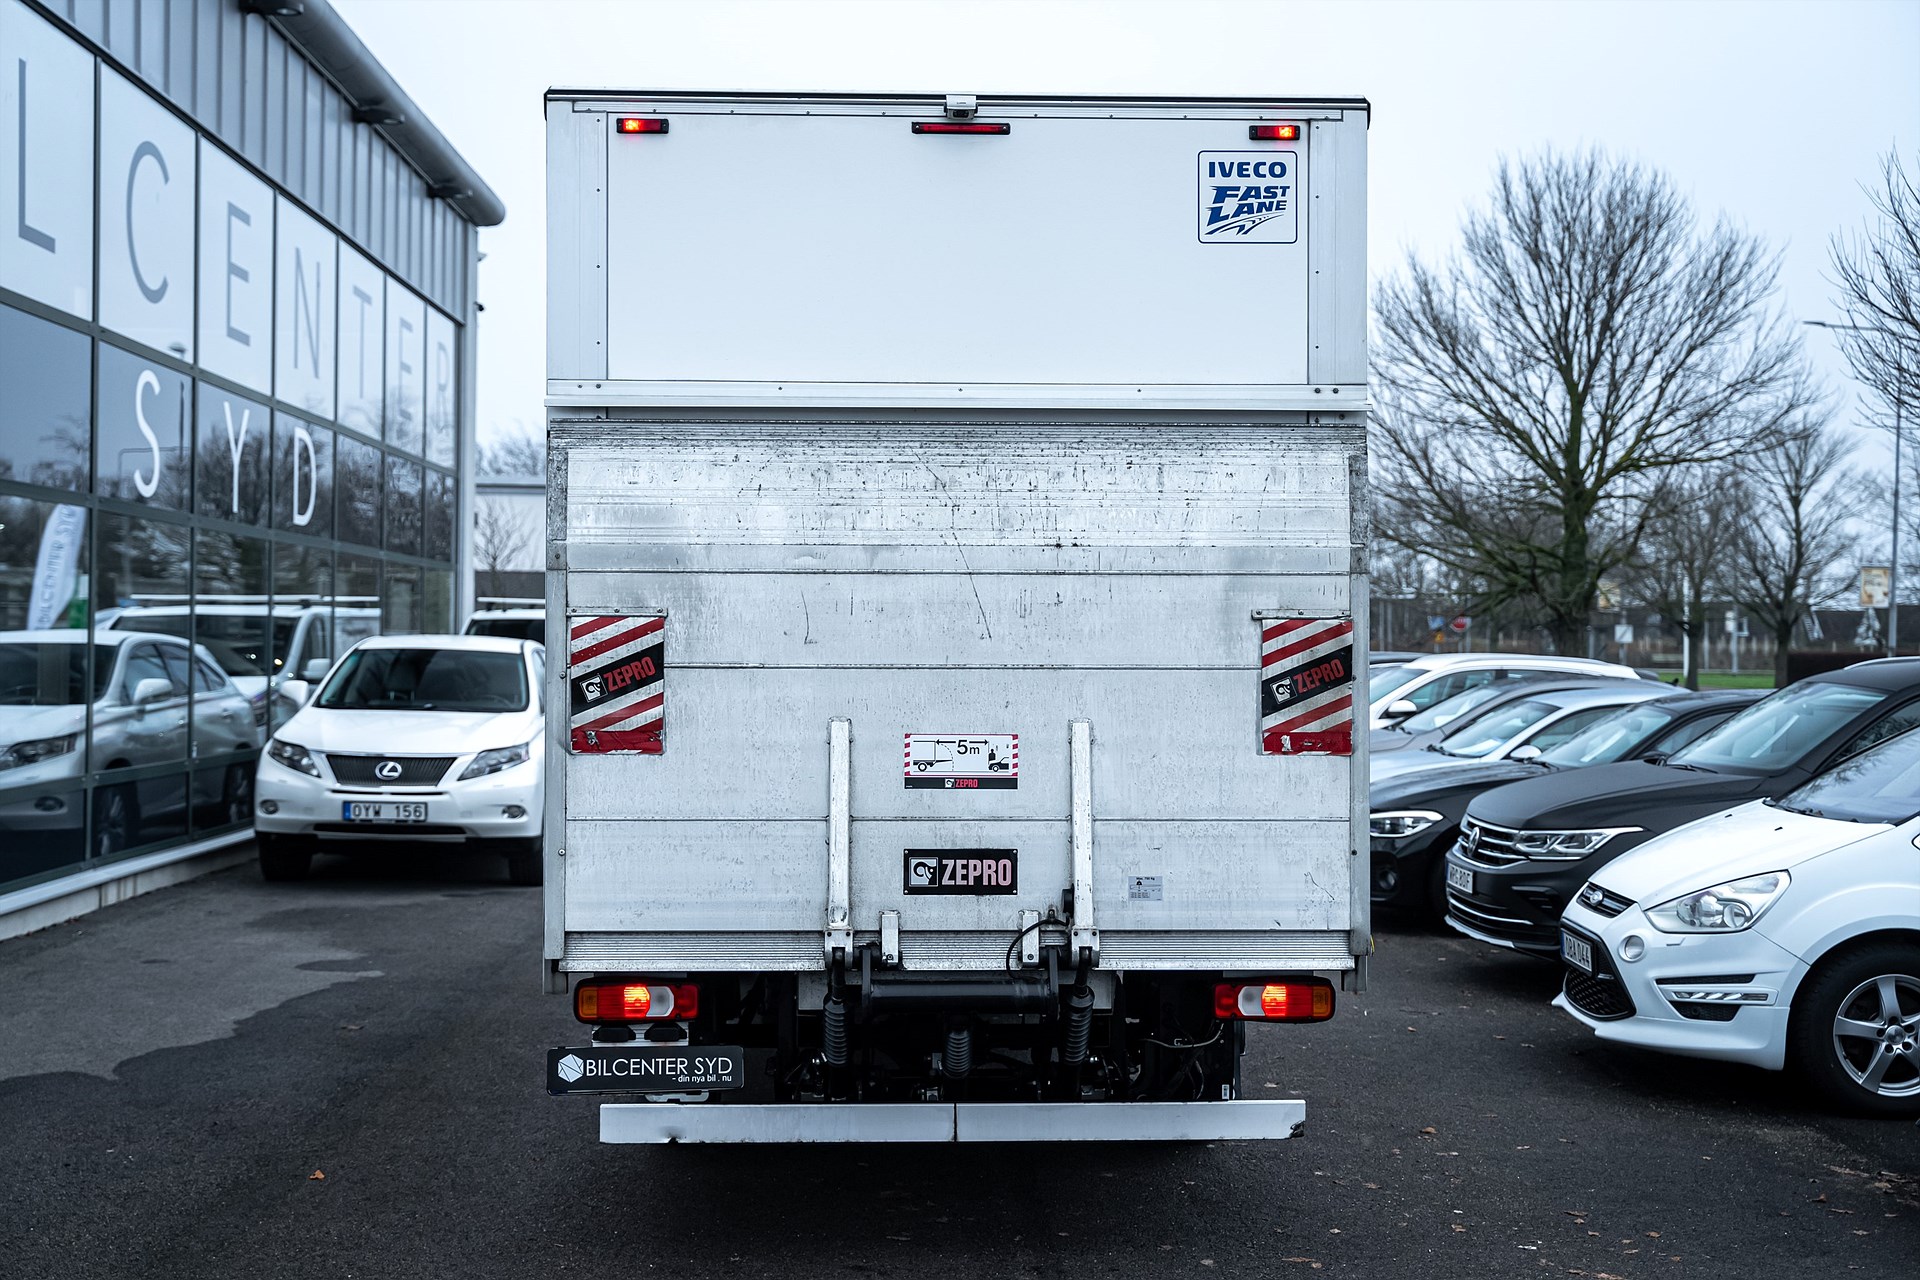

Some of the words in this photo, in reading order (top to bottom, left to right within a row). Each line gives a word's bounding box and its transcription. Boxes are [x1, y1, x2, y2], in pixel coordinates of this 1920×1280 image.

[1208, 161, 1287, 179] IVECO
[1209, 185, 1291, 205] FAST
[1205, 200, 1288, 227] LANE
[133, 369, 317, 527] SYD
[603, 656, 657, 692] ZEPRO
[1293, 658, 1345, 694] ZEPRO
[955, 779, 979, 788] ZEPRO
[352, 804, 381, 818] OYW
[395, 804, 423, 818] 156
[941, 859, 1012, 886] ZEPRO
[586, 1058, 689, 1076] BILCENTER
[694, 1057, 732, 1075] SYD
[691, 1075, 705, 1083] nya
